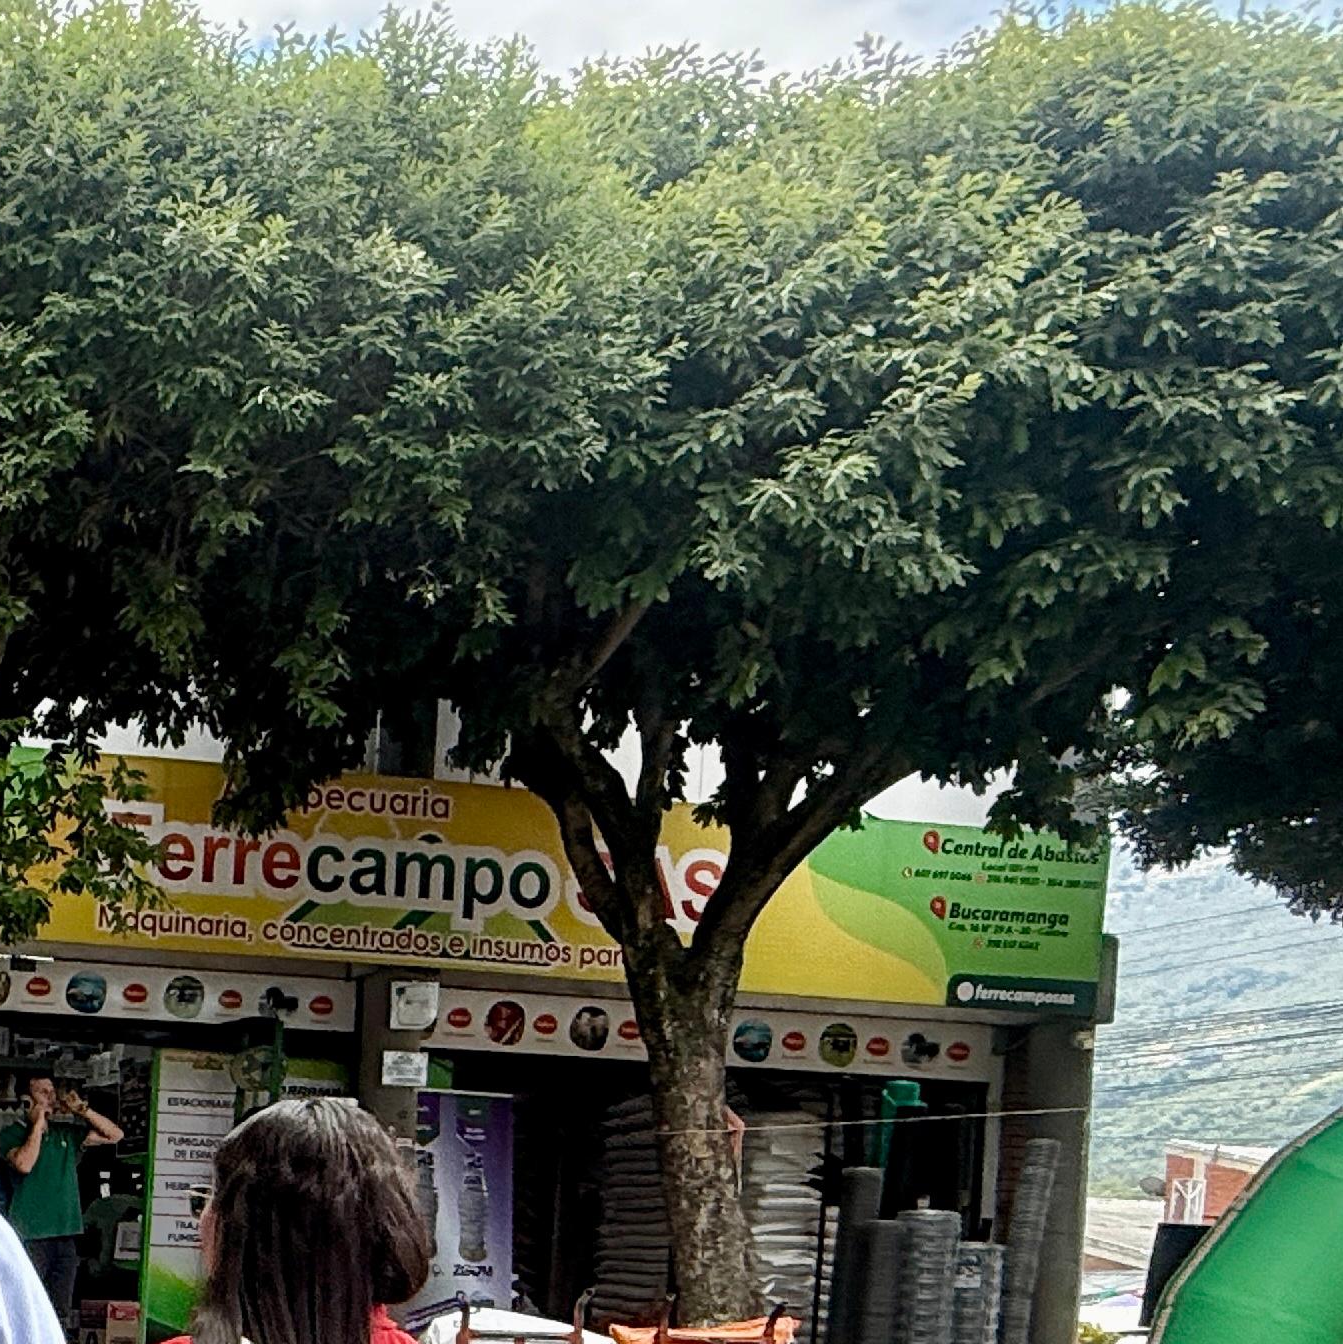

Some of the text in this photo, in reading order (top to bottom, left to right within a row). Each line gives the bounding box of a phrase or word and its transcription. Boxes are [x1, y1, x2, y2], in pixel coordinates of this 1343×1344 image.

[941, 837, 1004, 859] Central
[1008, 842, 1029, 860] de
[949, 901, 1070, 930] Bucaramanga
[263, 920, 441, 951] concentrados
[448, 933, 466, 954] e
[472, 937, 572, 963] insumos
[579, 948, 626, 970] par
